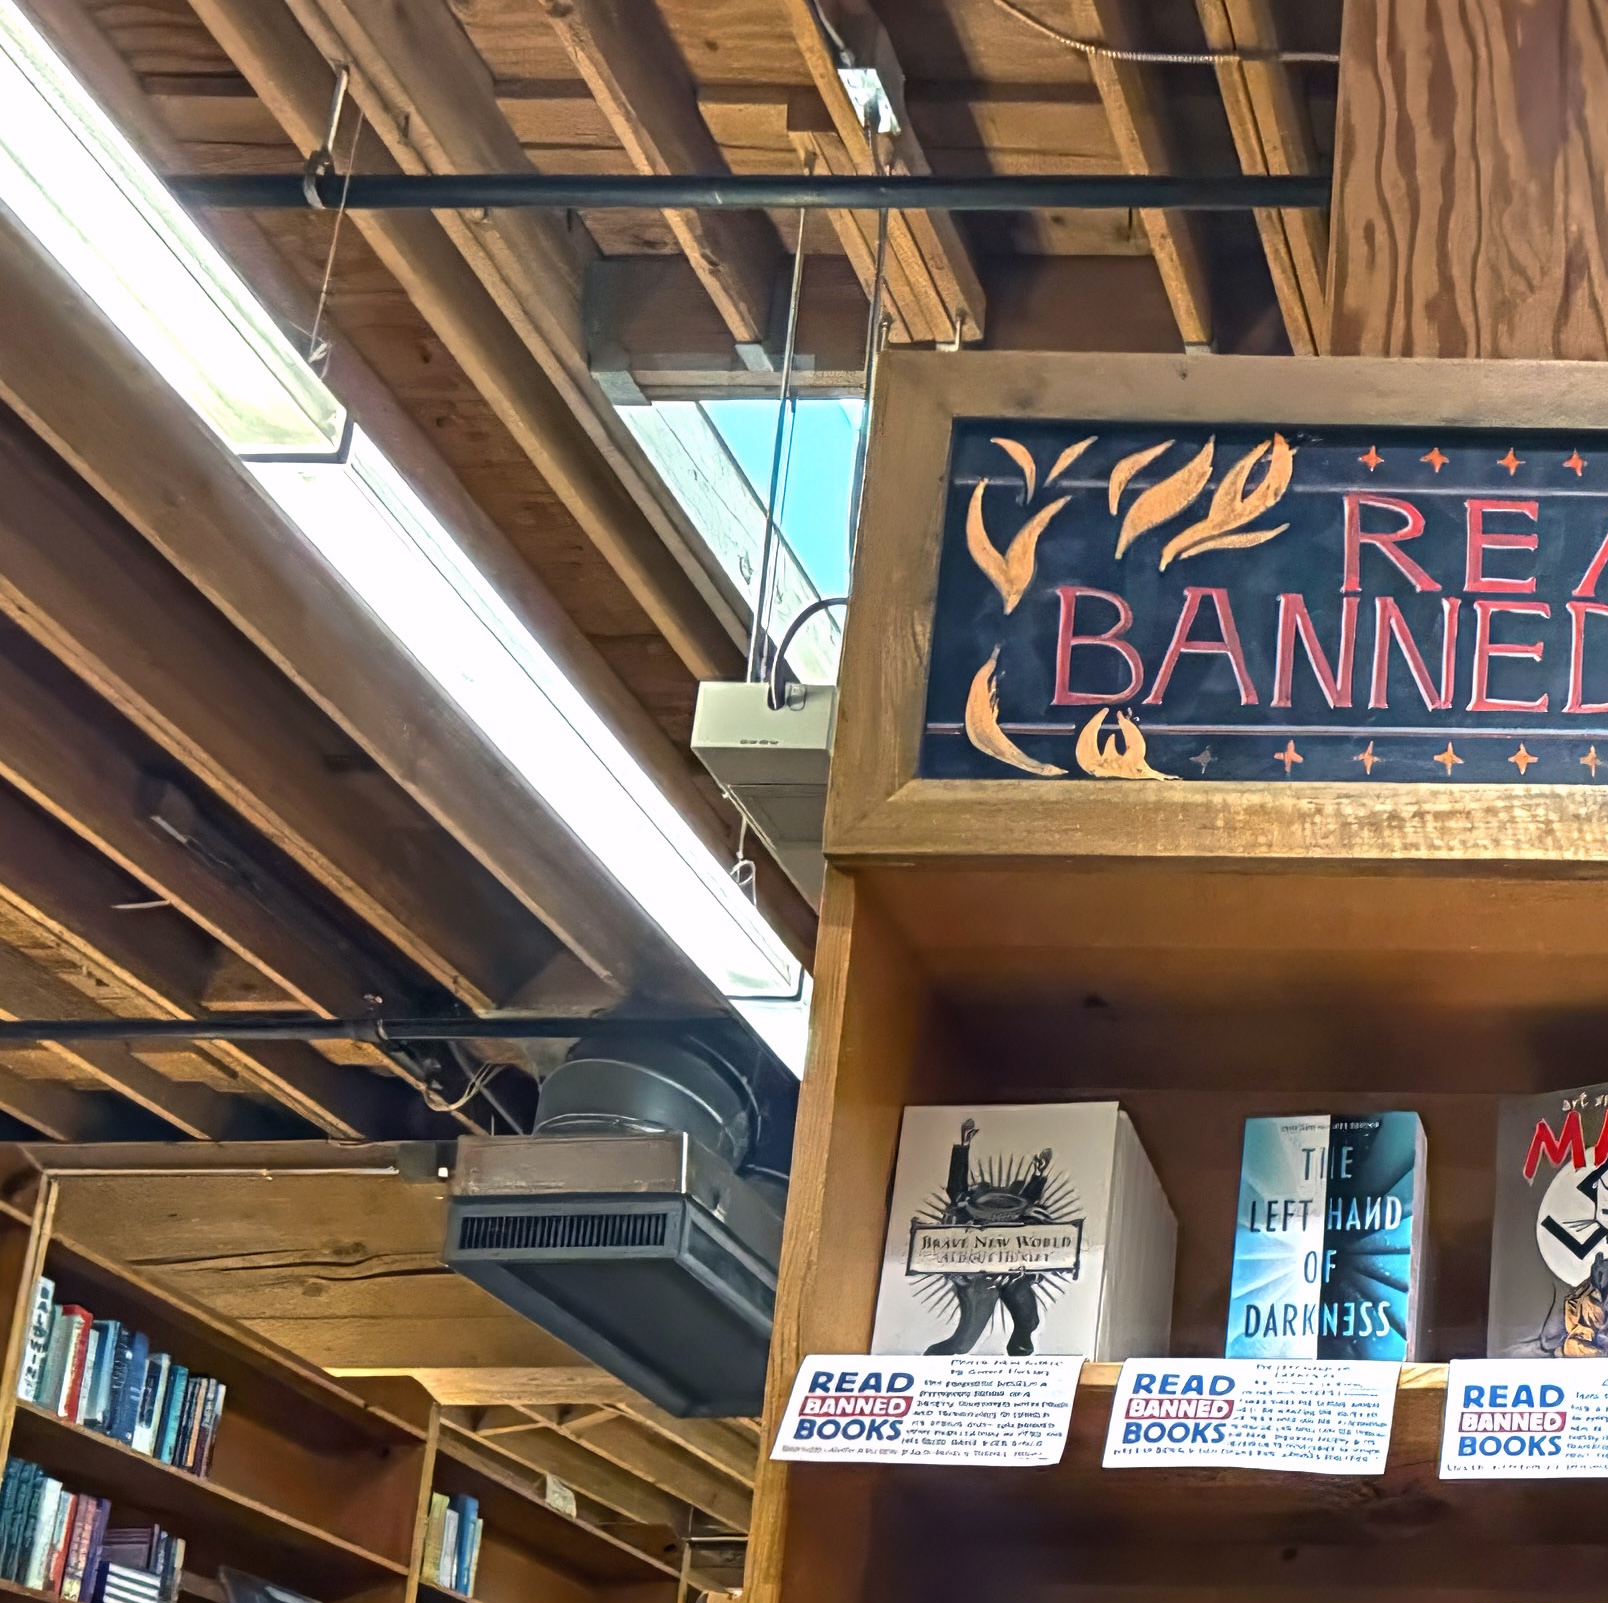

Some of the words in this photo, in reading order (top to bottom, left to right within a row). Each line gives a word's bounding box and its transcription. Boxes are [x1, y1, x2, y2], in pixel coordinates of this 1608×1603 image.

[1302, 1146, 1353, 1180] THE
[1250, 1199, 1313, 1232] LEFT
[1327, 1196, 1402, 1230] HAND
[1304, 1249, 1336, 1284] OF
[1245, 1301, 1390, 1338] DARKNESS
[809, 1372, 915, 1395] READ
[1135, 1373, 1235, 1396] READ
[803, 1398, 907, 1417] BANNED
[1464, 1385, 1564, 1408] READ
[1130, 1400, 1230, 1419] BANNED
[794, 1418, 902, 1441] BOOKS
[1123, 1422, 1226, 1444] BOOKS
[1461, 1413, 1562, 1432] BANNED
[1458, 1436, 1561, 1456] BOOKS
